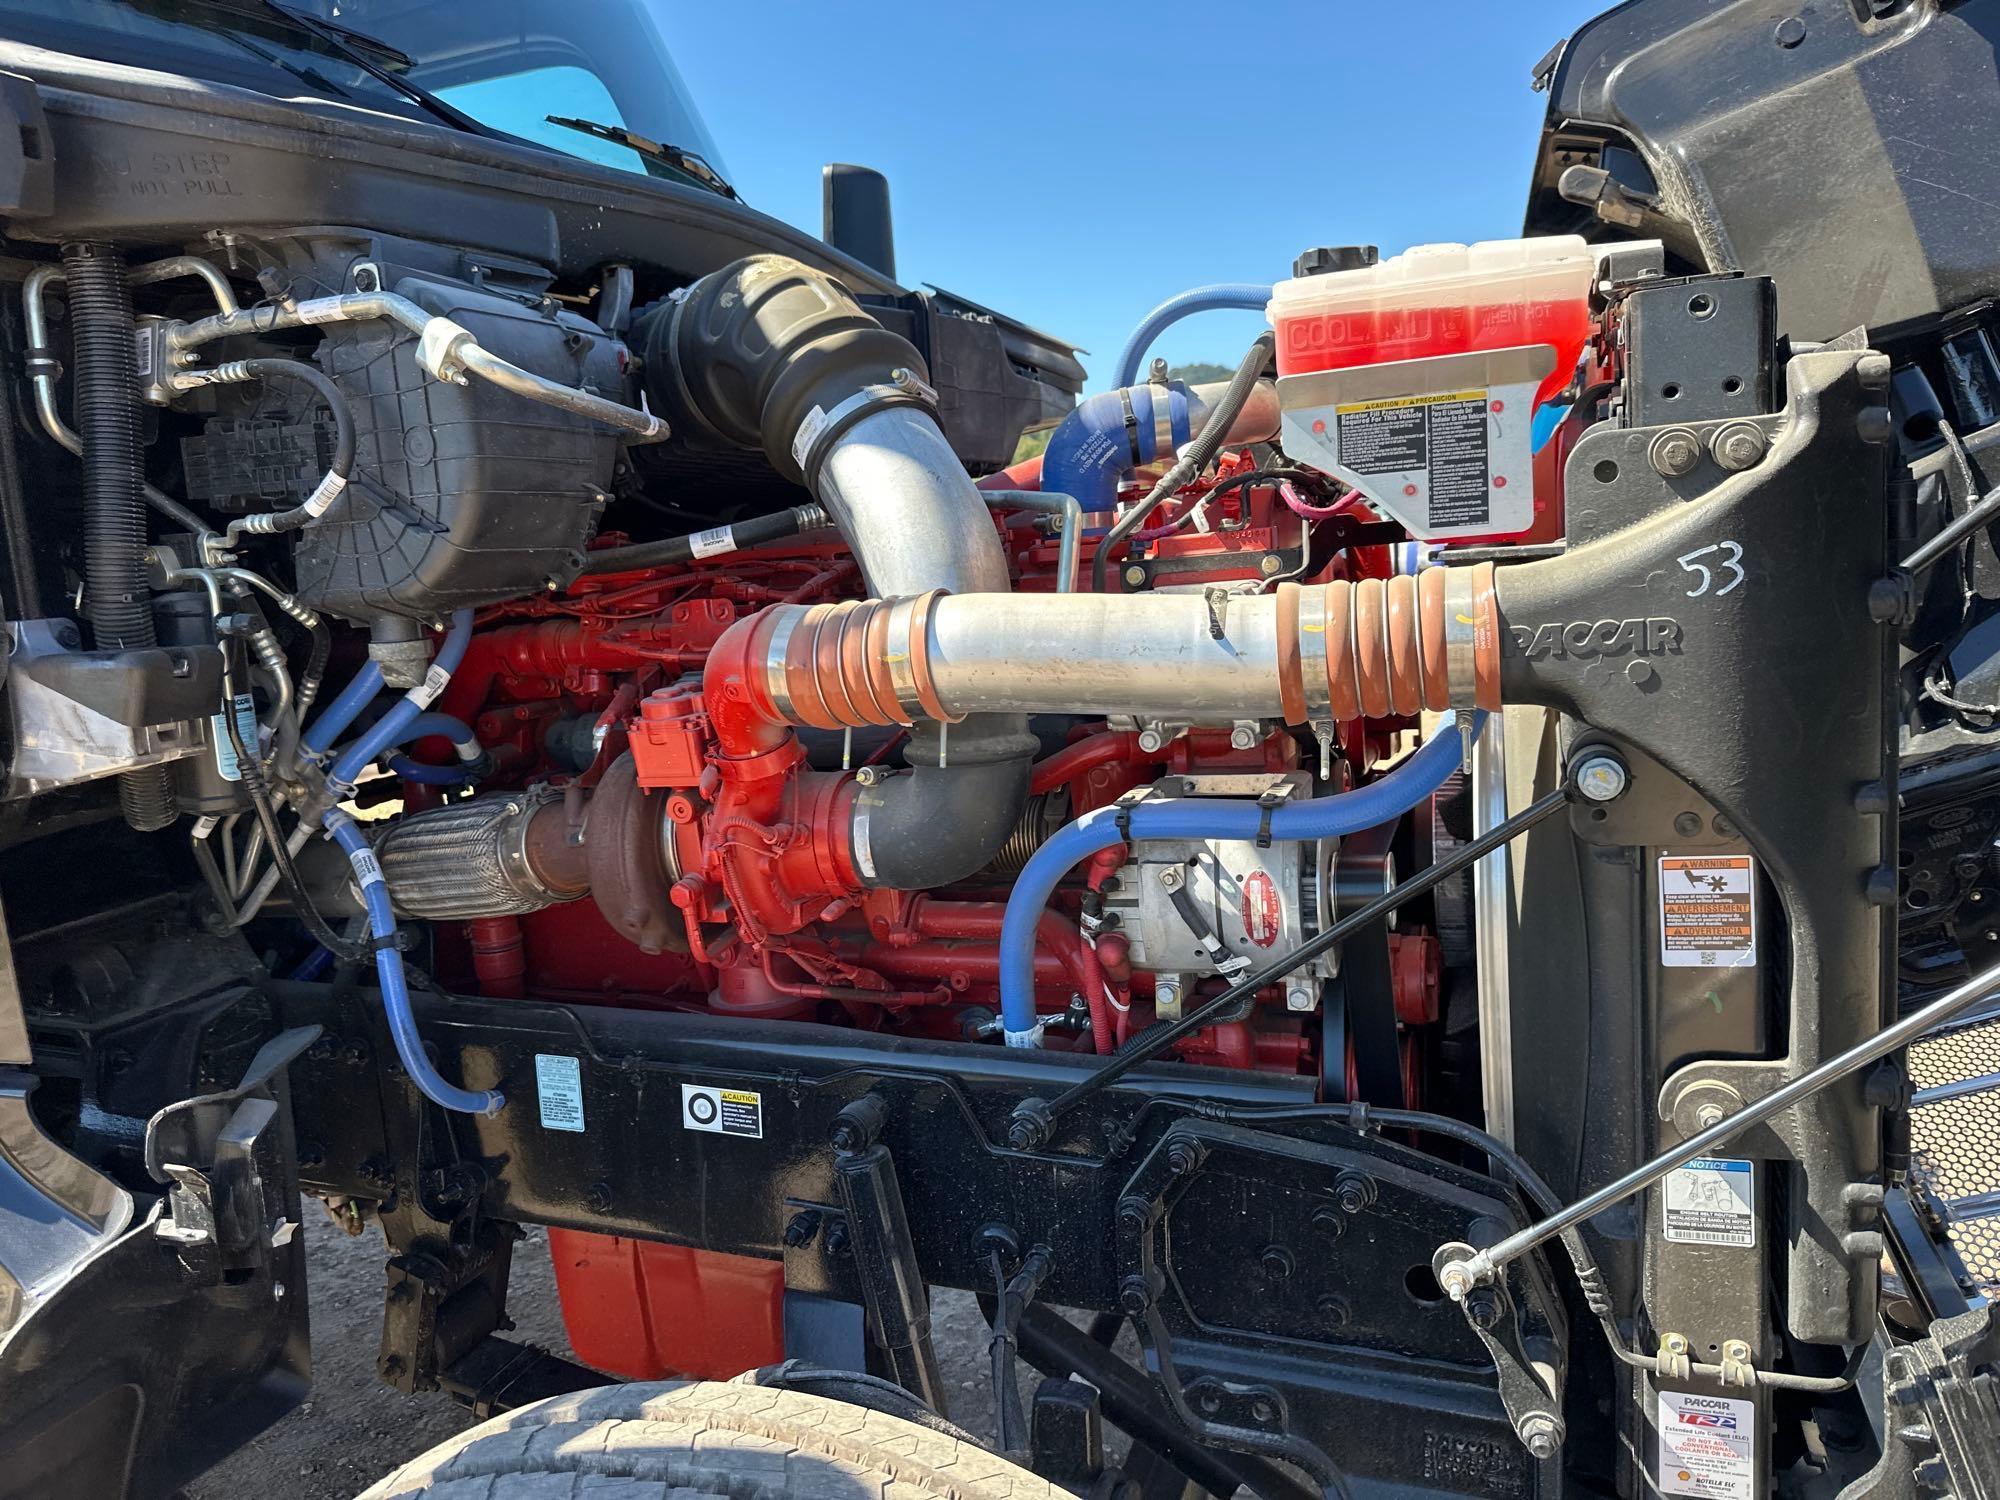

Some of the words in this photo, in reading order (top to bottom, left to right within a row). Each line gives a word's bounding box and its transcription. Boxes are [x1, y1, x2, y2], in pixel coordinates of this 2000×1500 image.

[152, 152, 231, 176] STEP
[1525, 304, 1554, 321] HOT
[1370, 400, 1399, 410] CAUTION
[1415, 394, 1457, 405] PRECAUCION
[1341, 411, 1368, 421] Radiator
[1382, 408, 1414, 416] Procedure
[1341, 417, 1370, 427] Required
[1383, 414, 1398, 422] This
[1398, 411, 1423, 420] Vehicle
[1676, 540, 1745, 598] 53
[1508, 616, 1682, 659] PACCAR
[1690, 860, 1731, 868] WARNING
[1677, 904, 1748, 913] AVERTISSEMENT
[1683, 927, 1743, 935] ADVERTENCIA
[727, 1093, 758, 1103] CAUTION
[1689, 1161, 1728, 1170] NOTICE
[1684, 1397, 1730, 1411] PACCAR
[1680, 1413, 1736, 1428] TRP
[1665, 1425, 1693, 1434] Extended
[1694, 1428, 1706, 1436] Life
[1707, 1430, 1731, 1439] Coolant
[1732, 1433, 1749, 1442] (ELC)
[1674, 1446, 1710, 1456] COOLANTS
[1682, 1441, 1733, 1452] CONVENTIONAL
[1696, 1477, 1724, 1487] ROTELLA
[1724, 1479, 1736, 1489] ELC
